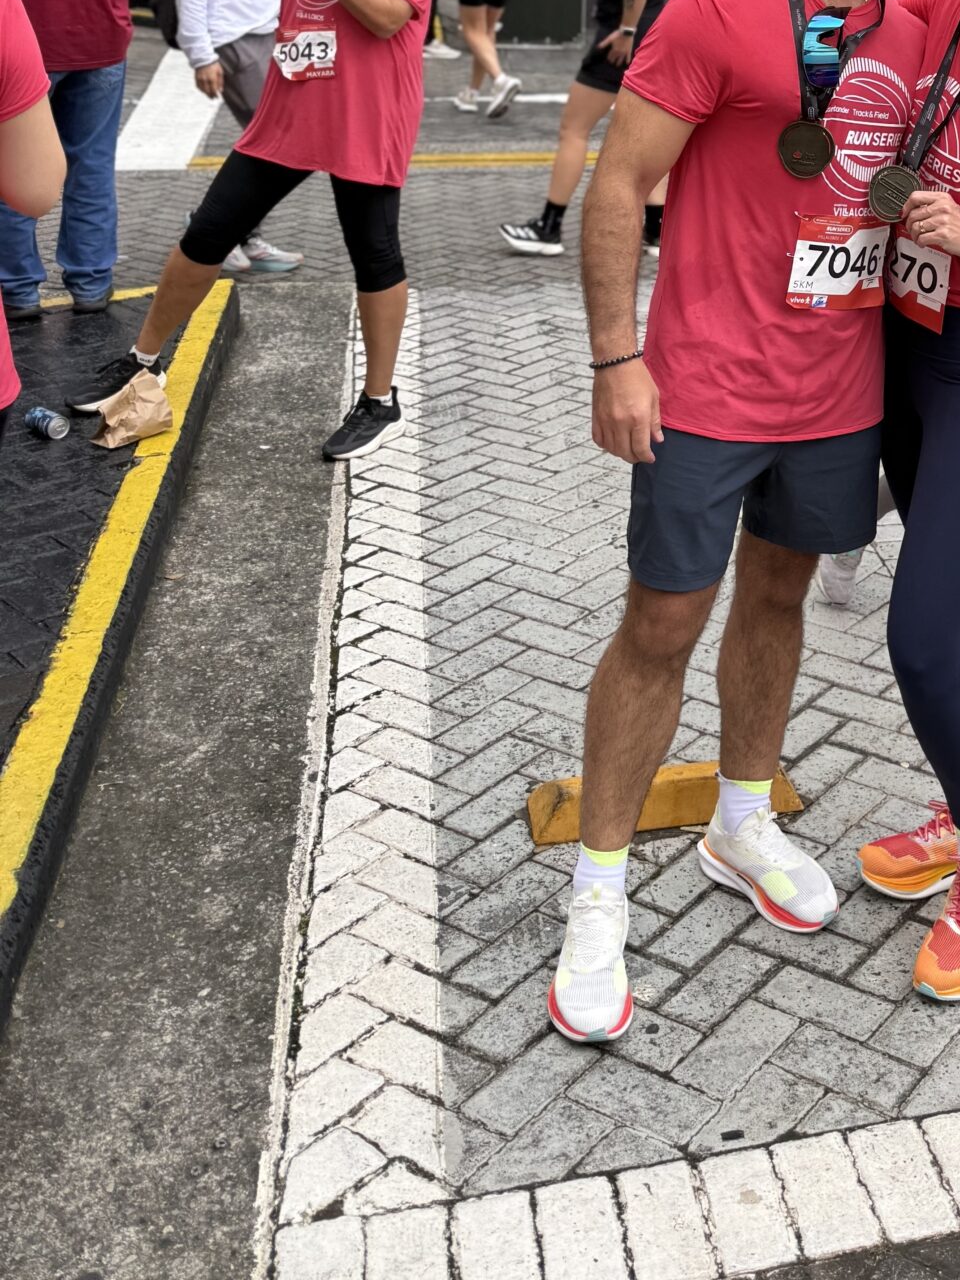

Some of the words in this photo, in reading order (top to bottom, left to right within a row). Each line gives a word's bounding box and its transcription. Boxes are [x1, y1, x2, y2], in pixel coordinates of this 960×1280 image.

[279, 41, 329, 63] 5043
[306, 70, 335, 78] MAYARA
[806, 244, 880, 279] 7046
[889, 252, 937, 294] 70
[793, 280, 814, 289] 5KM
[790, 296, 805, 304] vivo
